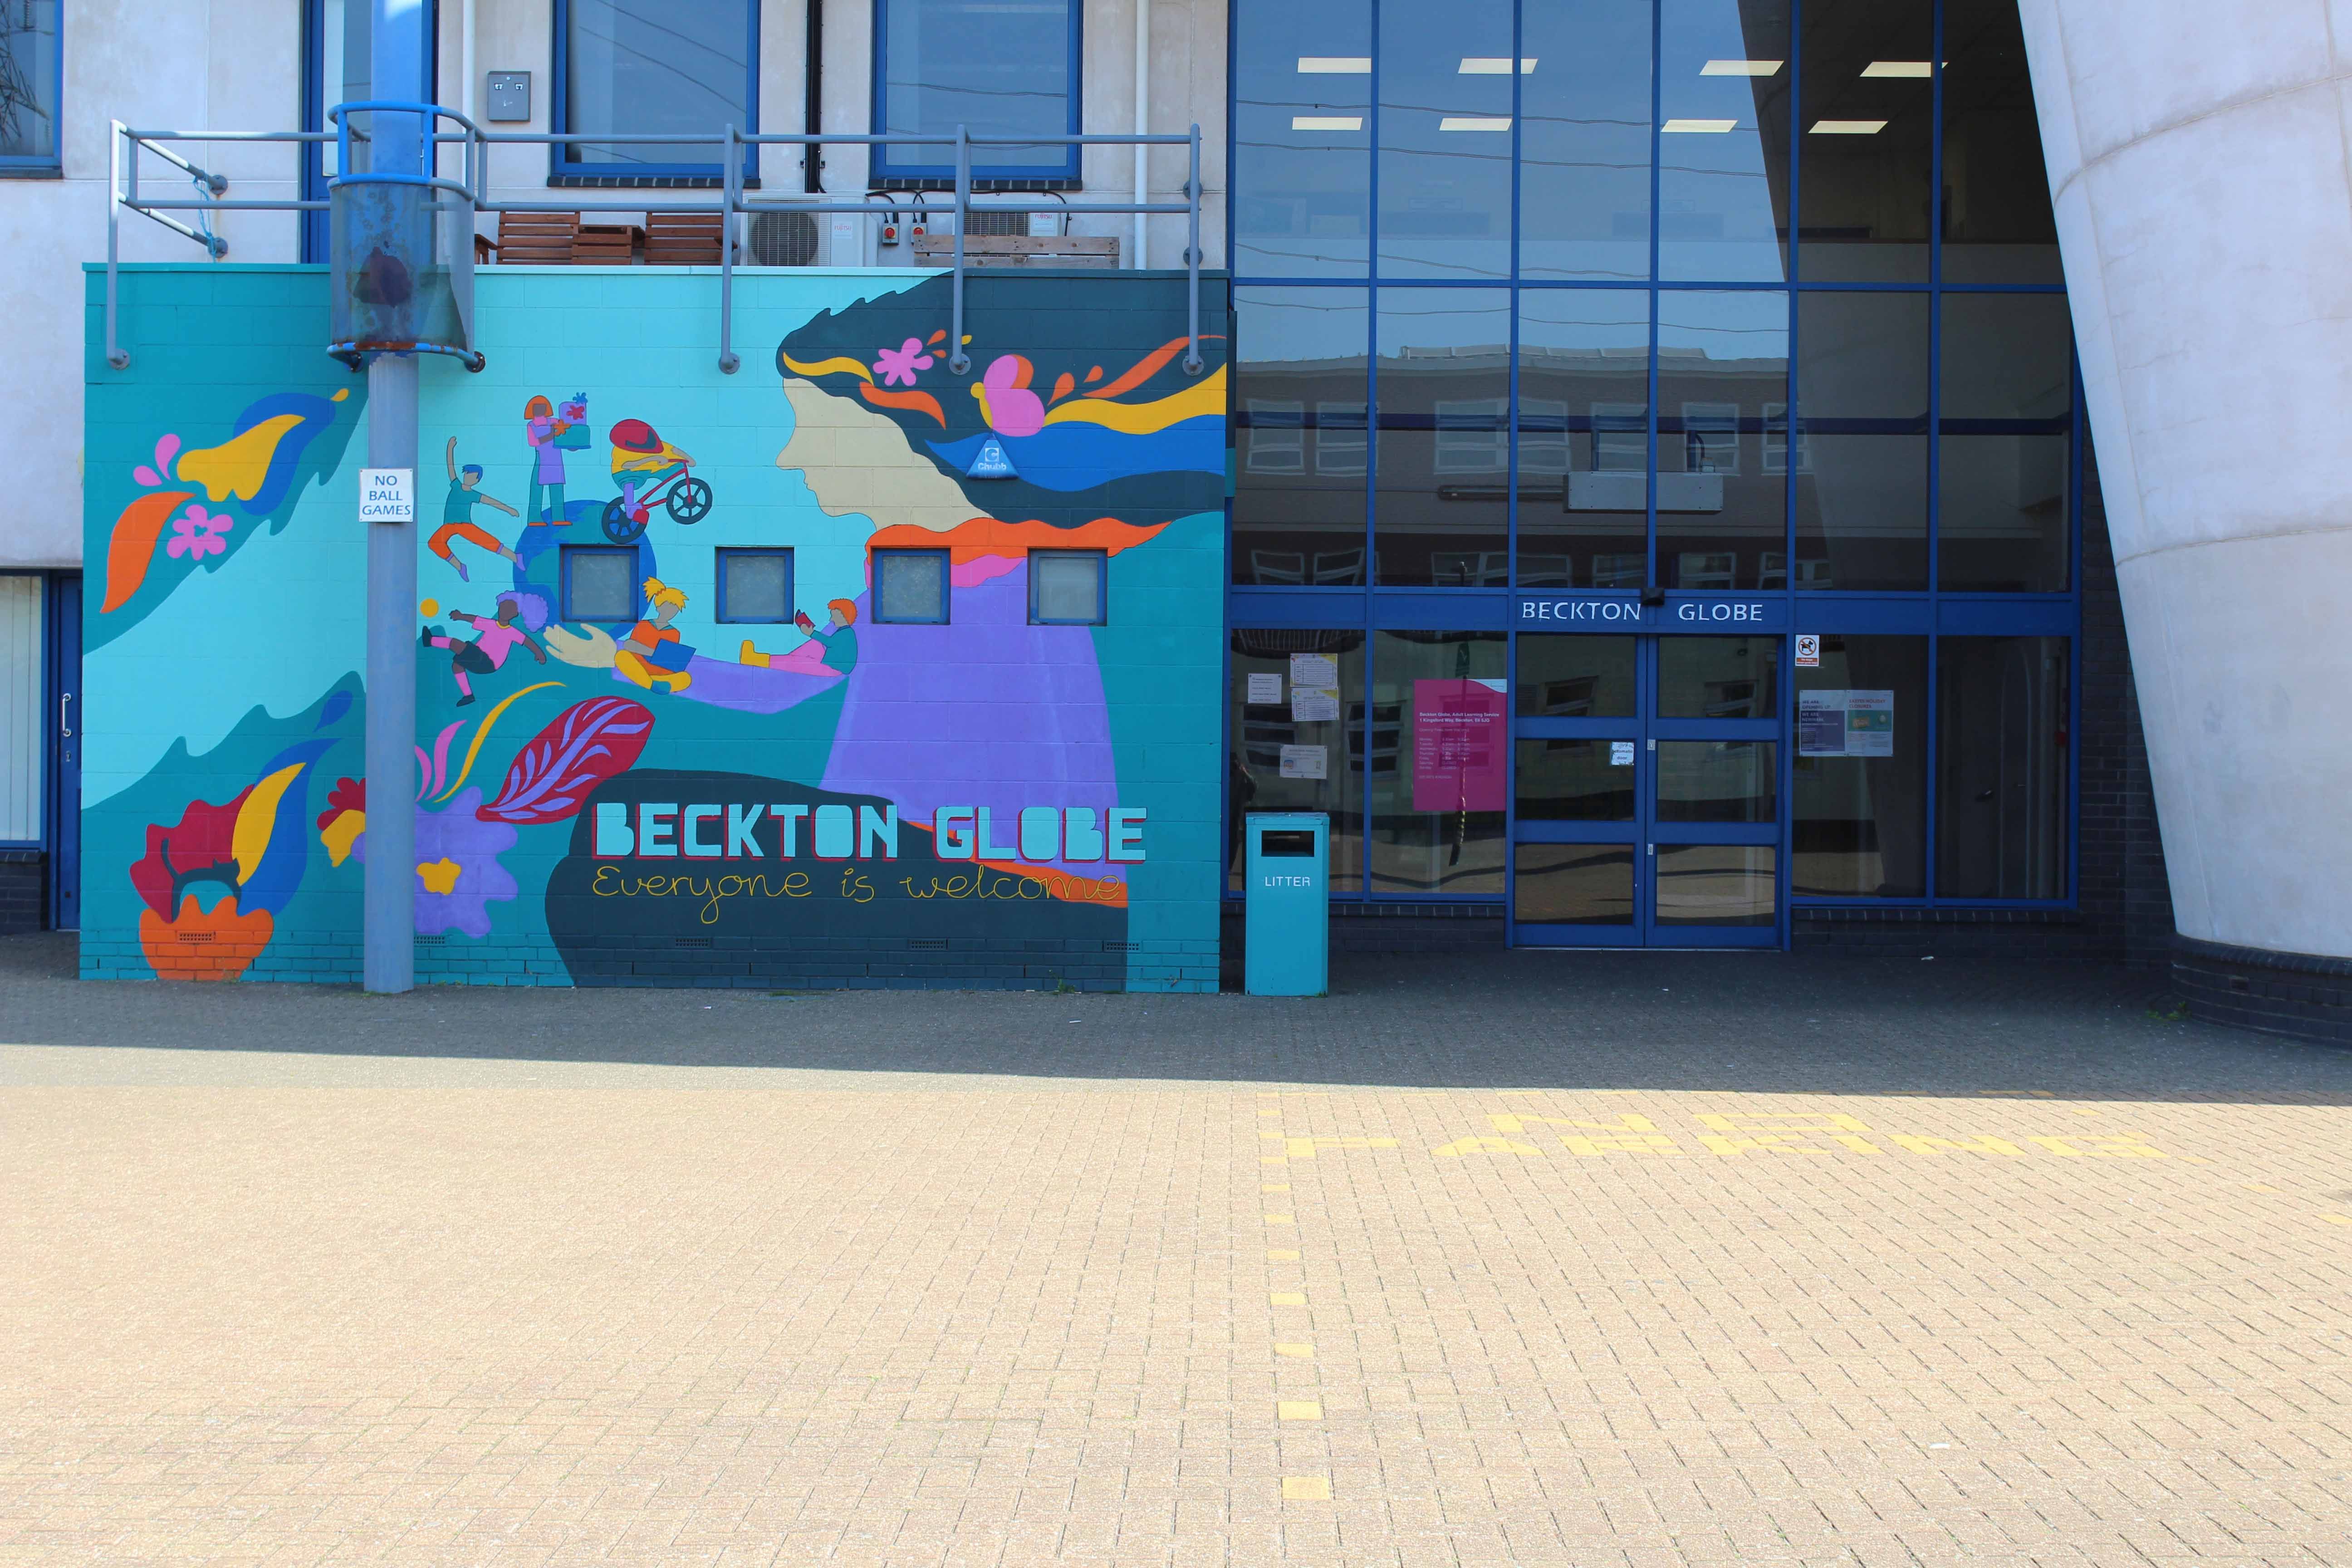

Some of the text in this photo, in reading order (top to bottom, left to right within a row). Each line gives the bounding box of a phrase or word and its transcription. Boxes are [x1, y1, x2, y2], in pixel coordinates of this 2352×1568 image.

[375, 475, 397, 486] NO
[369, 490, 403, 501] BALL
[362, 505, 411, 515] GAMES
[1522, 602, 1763, 621] BECKTON GLOBE
[592, 802, 1148, 863] BECKTON GLOBE
[1265, 876, 1310, 887] LITTER
[593, 864, 1122, 924] Everyone is welcome
[1487, 1112, 1874, 1132] NO
[1285, 1132, 2171, 1157] PARKING
